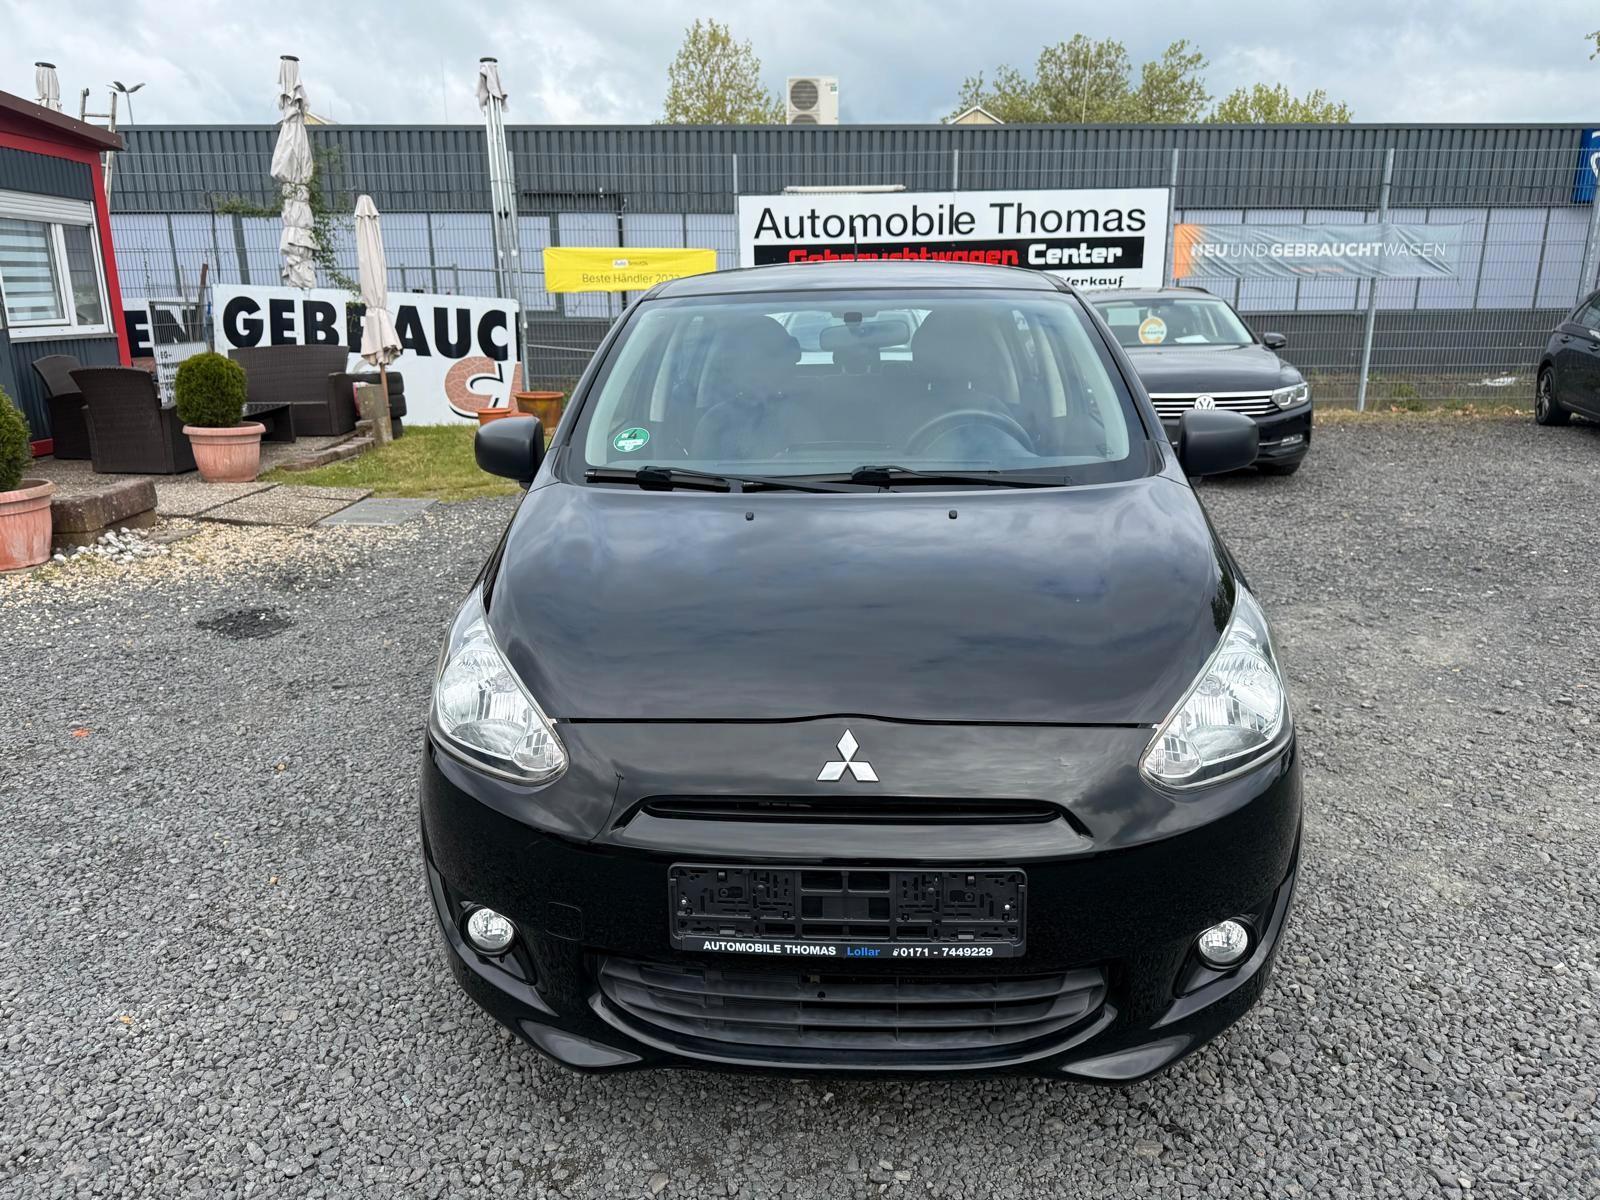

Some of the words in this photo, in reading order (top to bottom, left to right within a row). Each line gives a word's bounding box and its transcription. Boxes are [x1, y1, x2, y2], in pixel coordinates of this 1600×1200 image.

[754, 203, 976, 239] Automobile
[989, 202, 1146, 234] Thomas
[1028, 242, 1123, 265] Center
[582, 273, 611, 284] Beste
[613, 272, 654, 284] Händler
[222, 295, 521, 362] GEBAUC
[703, 941, 782, 954] AUTOMOBILE
[785, 944, 837, 956] THOMAS
[847, 946, 881, 957] Lollar
[900, 947, 929, 957] 0171
[942, 947, 994, 957] 7449229
